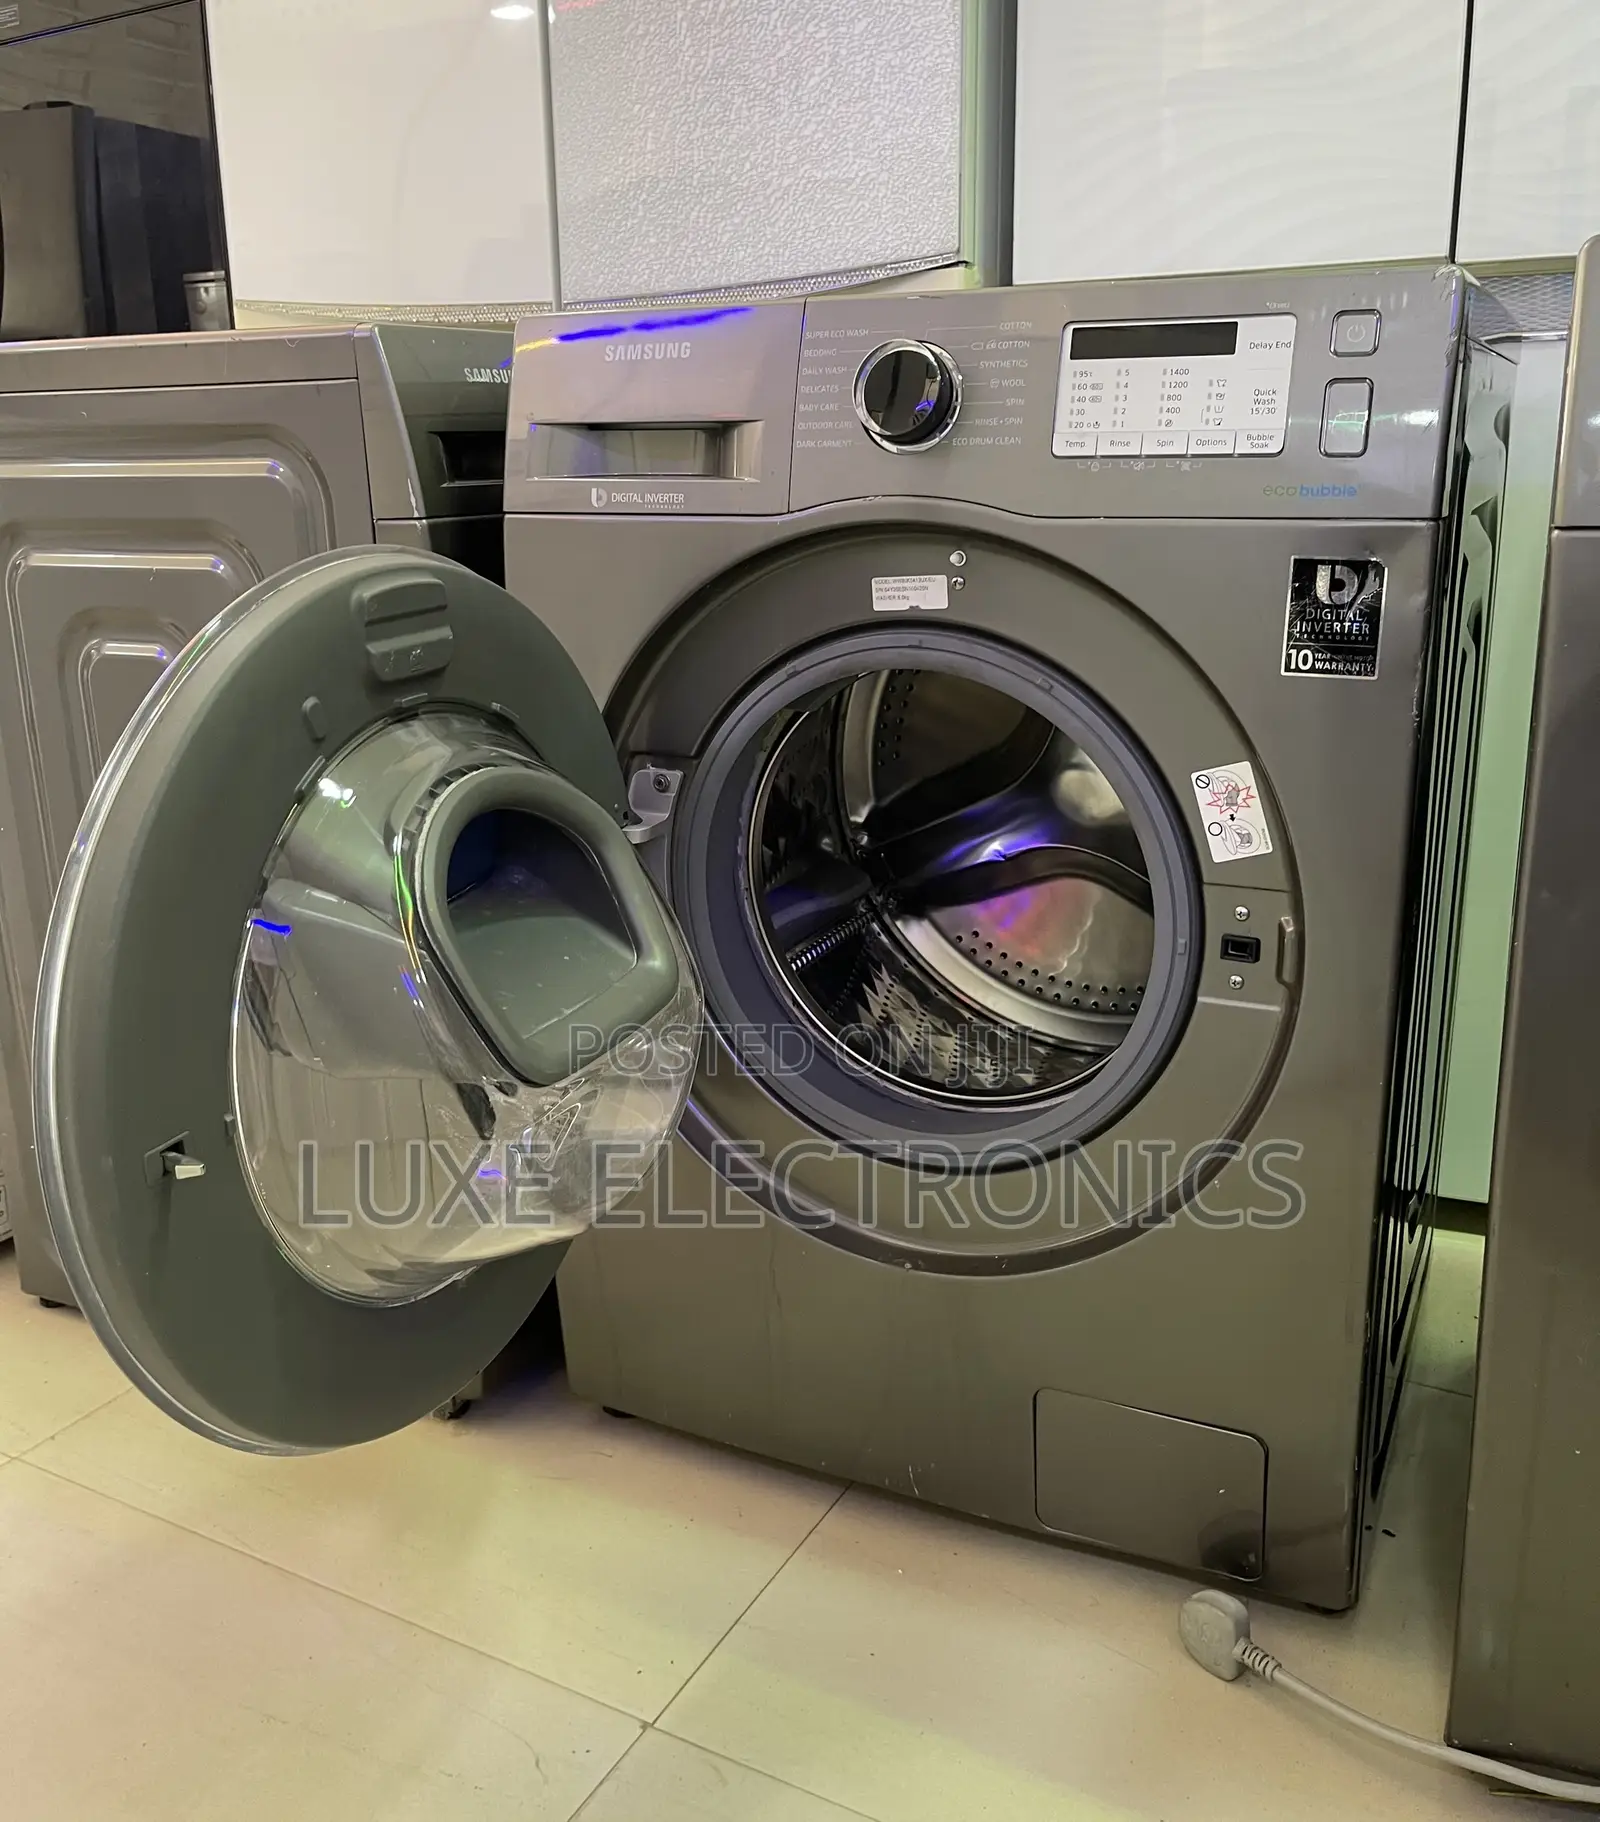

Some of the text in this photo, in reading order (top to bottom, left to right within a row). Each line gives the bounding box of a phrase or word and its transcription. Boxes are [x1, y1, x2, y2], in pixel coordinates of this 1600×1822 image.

[1000, 321, 1032, 330] COTTON
[805, 329, 869, 340] SUPER ECO WASH
[998, 340, 1030, 349] COTTON
[1249, 341, 1291, 350] Delay End
[604, 342, 691, 361] SAMSUNG
[804, 349, 837, 357] BEDDING
[979, 360, 1028, 369] SYNTHETICS
[802, 366, 847, 375] DAILY WASH
[1170, 368, 1189, 376] 1400
[1002, 379, 1026, 387] WOOL
[1077, 383, 1088, 391] 60
[801, 384, 839, 393] DELICATES
[1254, 388, 1277, 397] Quick
[1005, 398, 1025, 406] SPIN
[820, 403, 839, 411] CARE
[1075, 408, 1085, 416] 30
[798, 421, 853, 430] OUTDOOR CARE
[975, 417, 1023, 426] RINSE SPIN
[1074, 421, 1084, 429] 20
[796, 439, 853, 448] DARK GARMENT
[952, 437, 1022, 446] ECO DRUM CLEAN
[1065, 441, 1086, 449] Temp.
[1156, 439, 1174, 448] Spin
[1196, 438, 1227, 446] Options
[1250, 441, 1269, 449] Soak
[611, 493, 685, 503] DIGITAL INVERTER
[1305, 608, 1363, 621] DIGITAL
[1296, 621, 1370, 634] INVERTER
[1287, 649, 1313, 670] 10
[1315, 661, 1372, 671] WARRANTY
